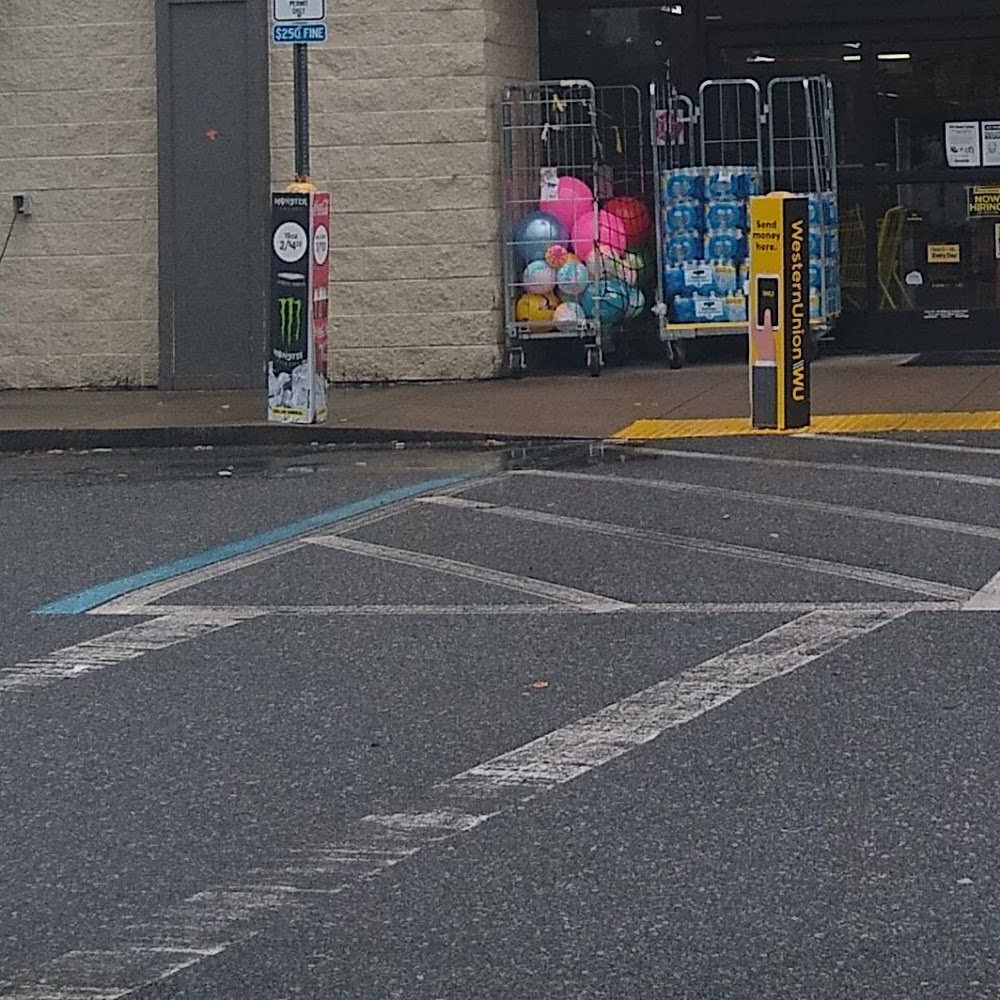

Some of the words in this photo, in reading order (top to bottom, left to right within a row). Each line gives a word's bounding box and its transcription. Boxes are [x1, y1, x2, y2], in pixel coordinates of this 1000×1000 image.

[275, 27, 301, 41] $250
[303, 27, 325, 39] FINE
[974, 194, 1000, 203] NOW
[756, 220, 777, 229] Send
[752, 232, 781, 241] money
[755, 242, 778, 251] here.
